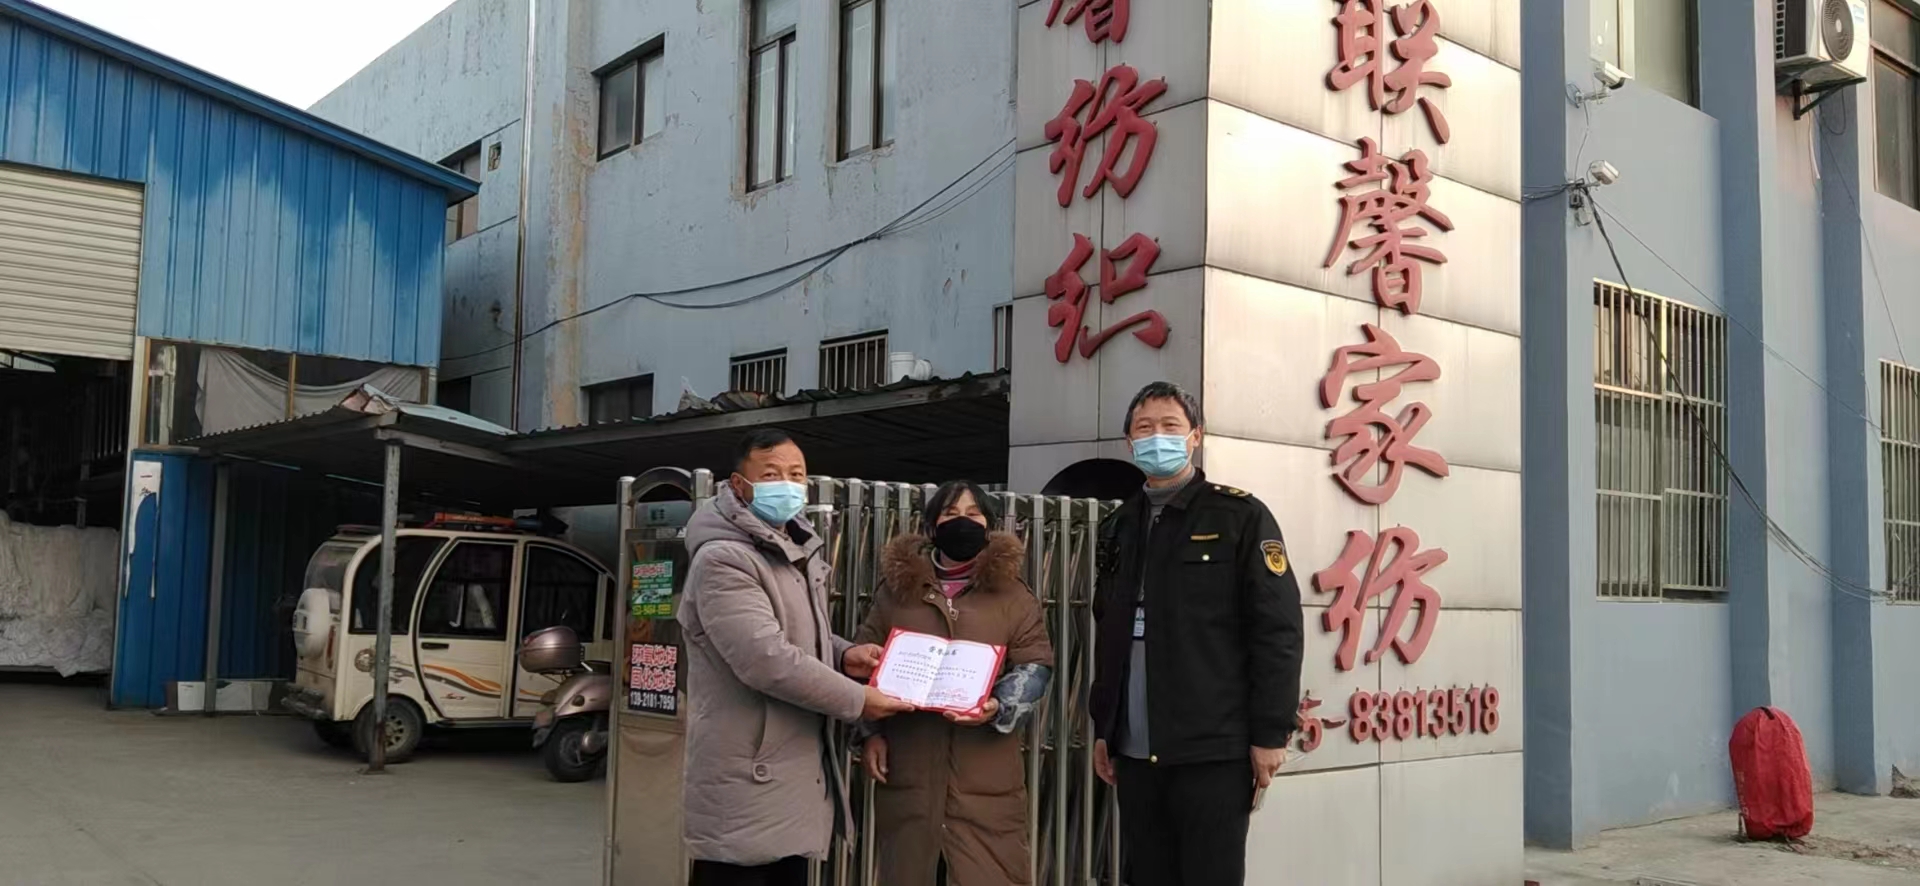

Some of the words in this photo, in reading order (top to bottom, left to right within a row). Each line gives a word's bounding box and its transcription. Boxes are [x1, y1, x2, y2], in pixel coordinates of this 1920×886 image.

[1312, 0, 1454, 671] 联馨家纺
[1287, 686, 1500, 752] 5-83813518
